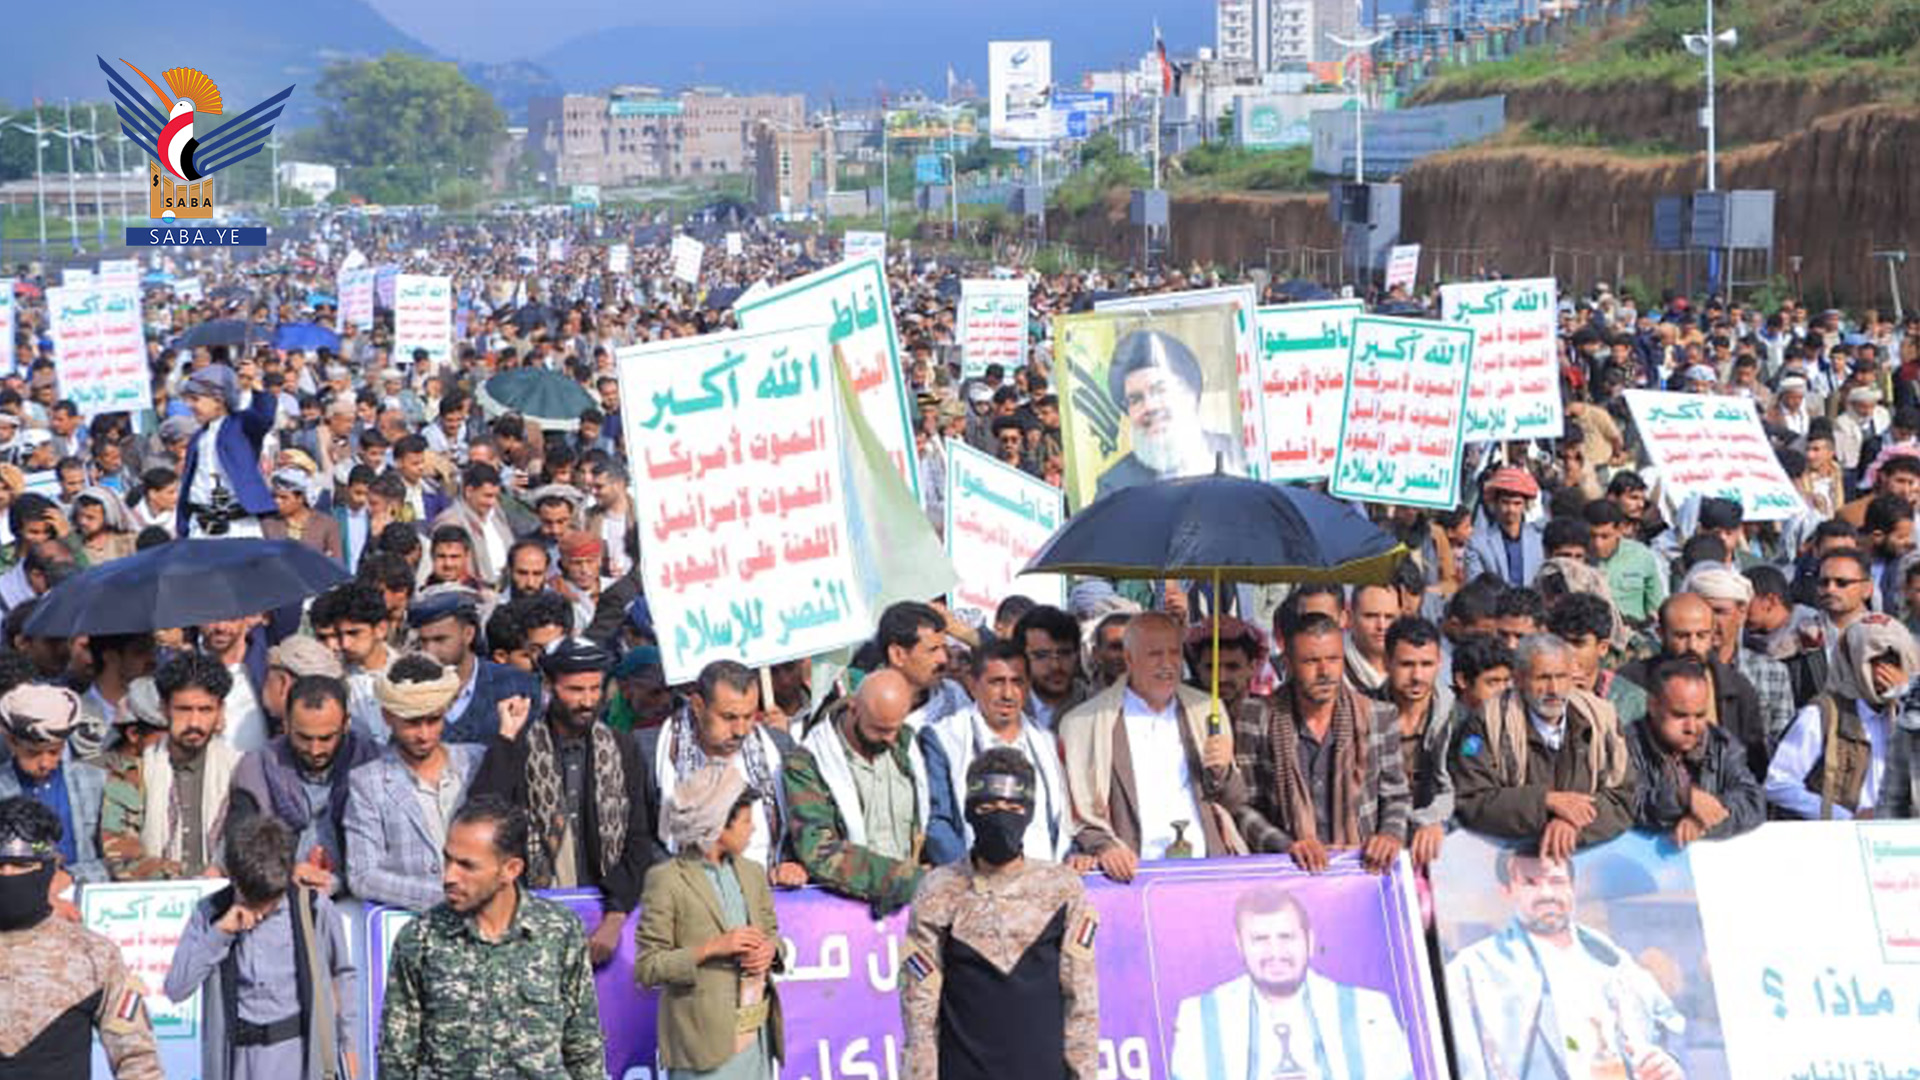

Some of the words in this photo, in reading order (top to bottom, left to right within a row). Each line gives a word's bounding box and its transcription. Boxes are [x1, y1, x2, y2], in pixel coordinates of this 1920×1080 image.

[828, 283, 879, 346] قاط
[1450, 284, 1509, 325] أكبر
[1512, 287, 1547, 310] الله
[1258, 320, 1348, 361] اطعوا
[1356, 329, 1424, 367] أكبر
[1424, 336, 1467, 366] الله
[639, 348, 747, 435] أكبر
[756, 346, 820, 399] الله
[645, 423, 744, 482] لأمريكا
[750, 415, 826, 466] الموت
[758, 468, 833, 519] الموت
[1397, 462, 1450, 493] النصر
[654, 486, 753, 542] لإسرائيل
[660, 543, 730, 594] اليهود
[738, 539, 777, 582] على
[783, 521, 840, 565] اللعنة
[674, 597, 764, 667] للإسلام
[776, 576, 852, 646] النصر
[1812, 966, 1895, 1017] ماذا
